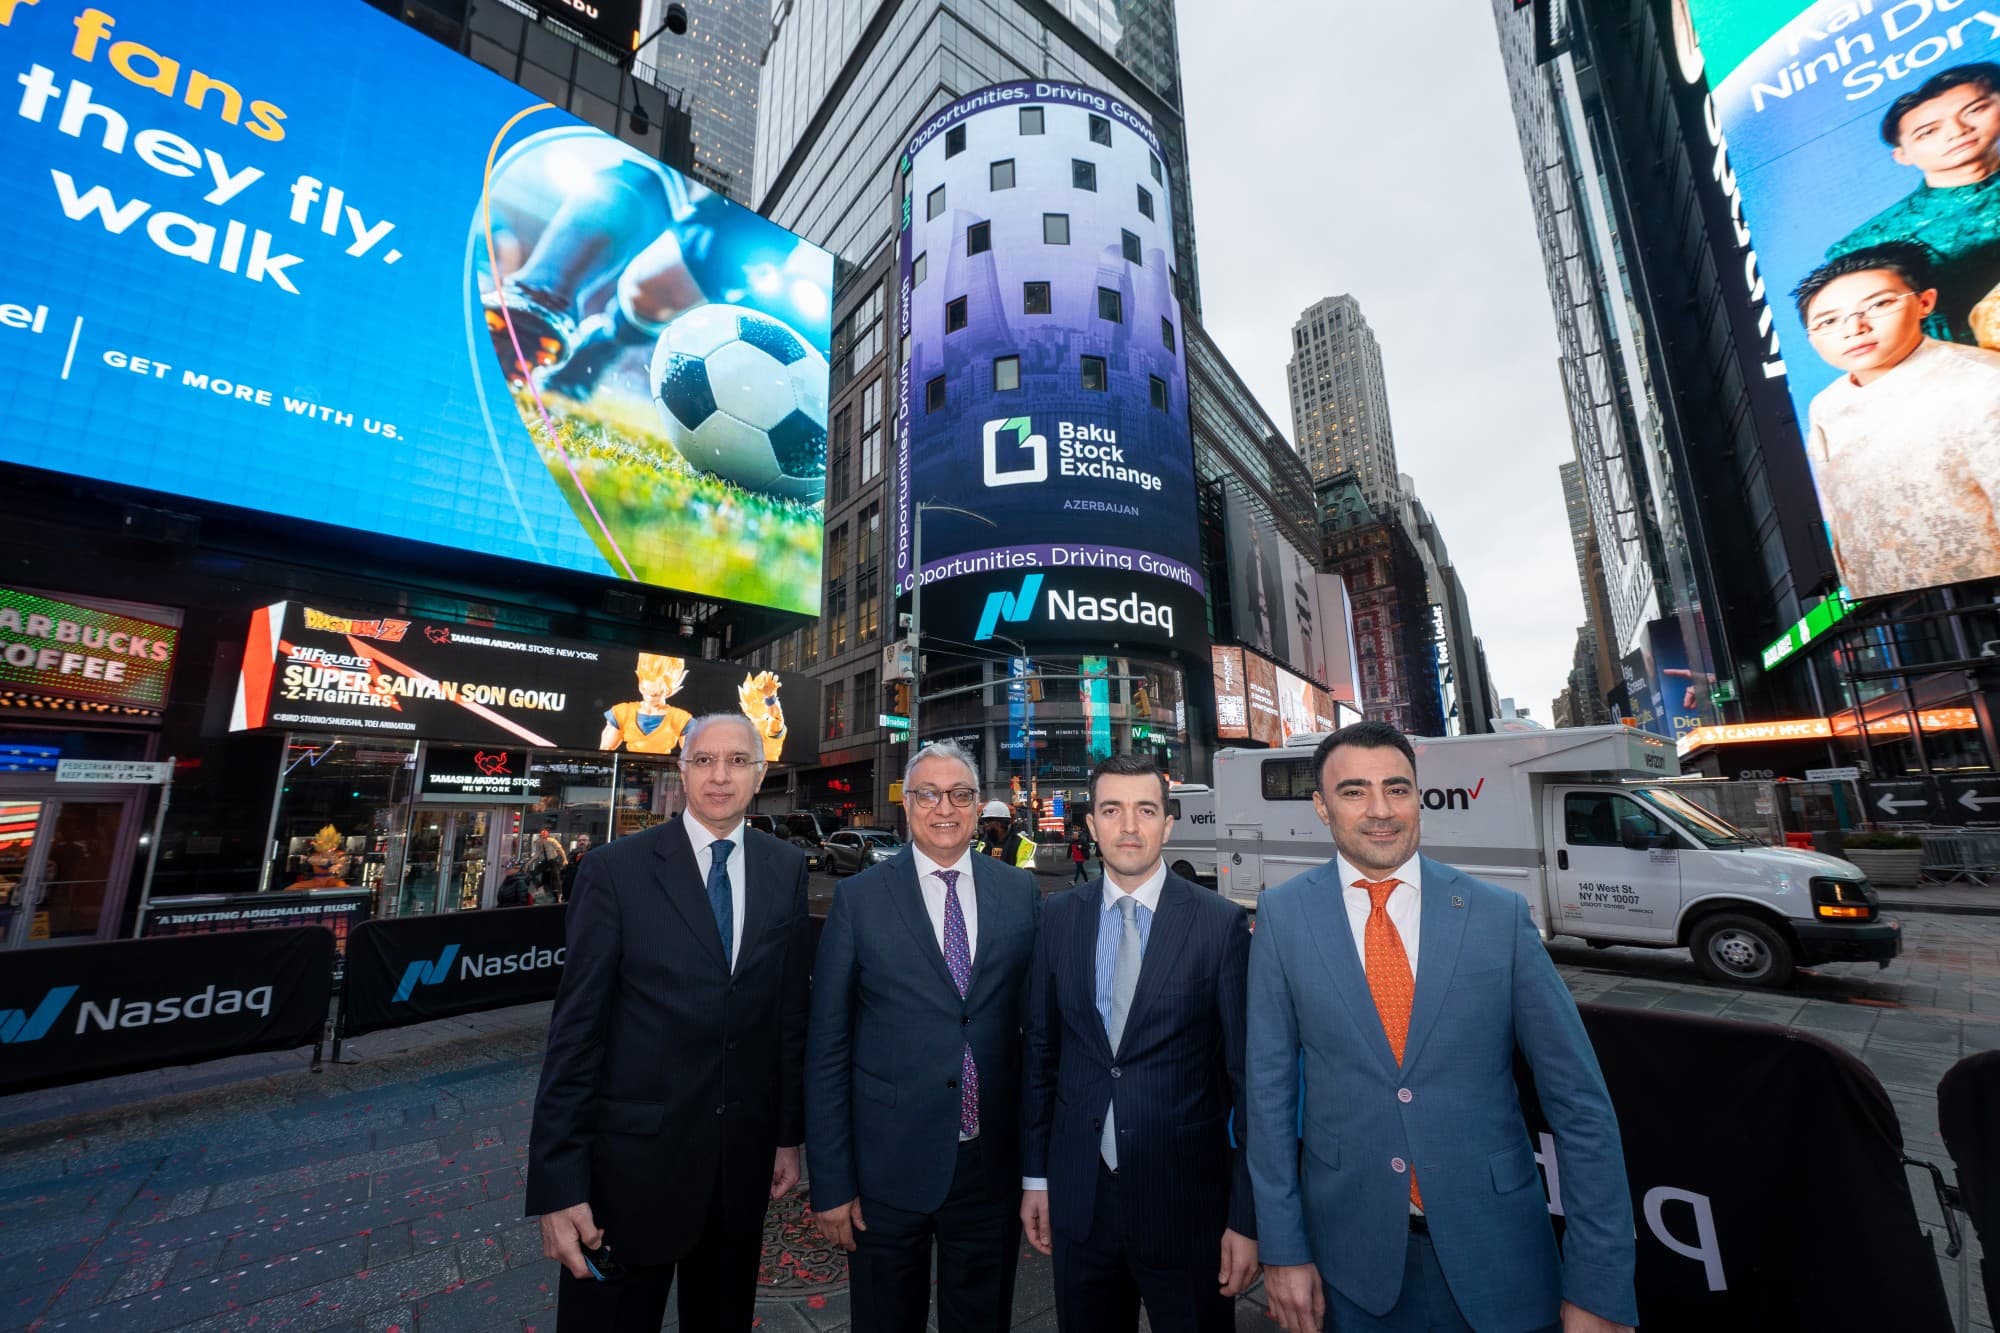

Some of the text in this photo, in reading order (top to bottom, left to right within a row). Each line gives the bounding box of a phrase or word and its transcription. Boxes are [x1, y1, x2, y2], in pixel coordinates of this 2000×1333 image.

[71, 8, 288, 142] fans
[1750, 32, 1875, 112] Ninh
[909, 83, 1160, 156] Opportunities, Driving Growth
[17, 63, 403, 265] they fly,
[50, 168, 304, 295] walk
[102, 350, 404, 441] GET MORE WITH US.
[1059, 421, 1116, 444] Baku
[1059, 439, 1125, 463] Stock
[1060, 458, 1162, 491] Exchange
[1064, 500, 1139, 516] AZERBAIJAN
[1052, 548, 1132, 570] Driving
[1139, 554, 1193, 586] Growth
[1048, 589, 1174, 638] Nasdaq
[0, 607, 168, 662] ARBUCKS
[528, 644, 555, 655] STORE
[556, 648, 575, 657] NEW
[575, 651, 598, 661] YORK
[1436, 640, 1449, 664] Foot
[282, 664, 566, 711] SUPER SAIYAN SON GOKU
[512, 778, 541, 787] STORE
[1578, 882, 1636, 894] 140 West St.
[1579, 892, 1640, 905] NY NY 10007
[172, 911, 240, 924] RIVETING
[241, 905, 323, 918] ADRENALINE
[75, 984, 273, 1034] Nasdaq
